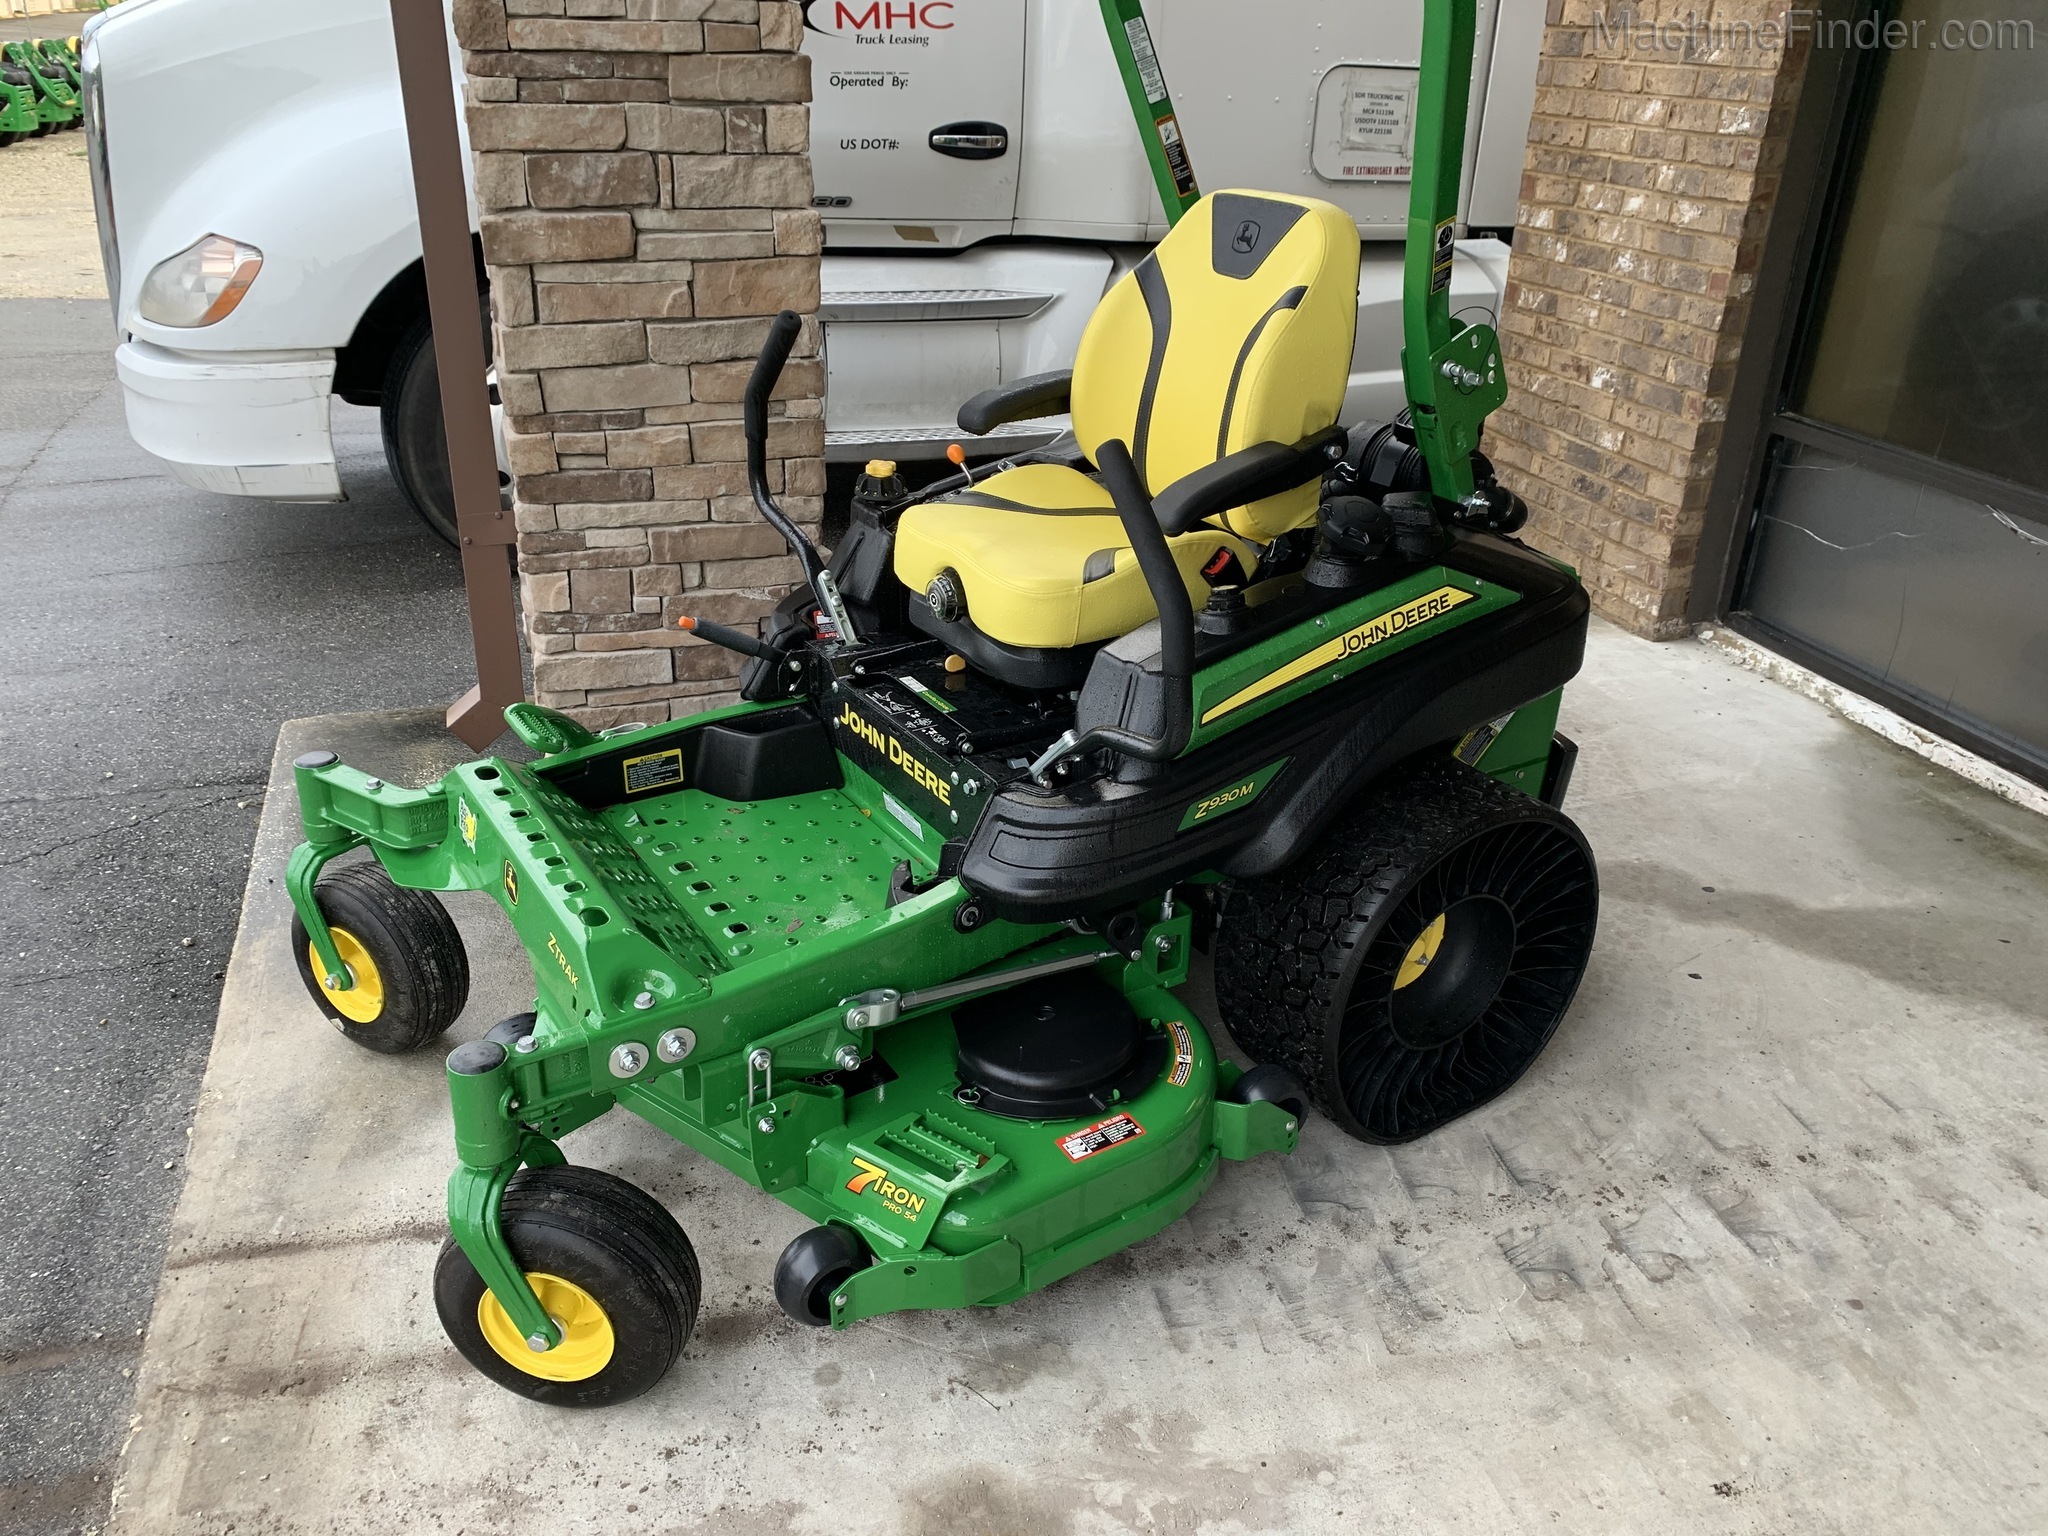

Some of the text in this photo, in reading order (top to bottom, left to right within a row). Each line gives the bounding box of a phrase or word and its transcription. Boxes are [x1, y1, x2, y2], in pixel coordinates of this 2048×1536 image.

[835, 1, 954, 30] MHC
[855, 33, 929, 47] Truck Leasing
[829, 75, 909, 90] Operated By:
[1367, 92, 1394, 100] TRUCKING
[840, 138, 899, 150] US DOT#:
[1342, 165, 1411, 175] FIRE EXTINGUISHER INSIDE
[1337, 593, 1452, 658] JOHN DEERE
[840, 702, 951, 806] JOHN DEERE
[1194, 781, 1255, 820] Z930M
[547, 931, 579, 991] ZTRAK
[882, 1200, 918, 1222] PRO 54
